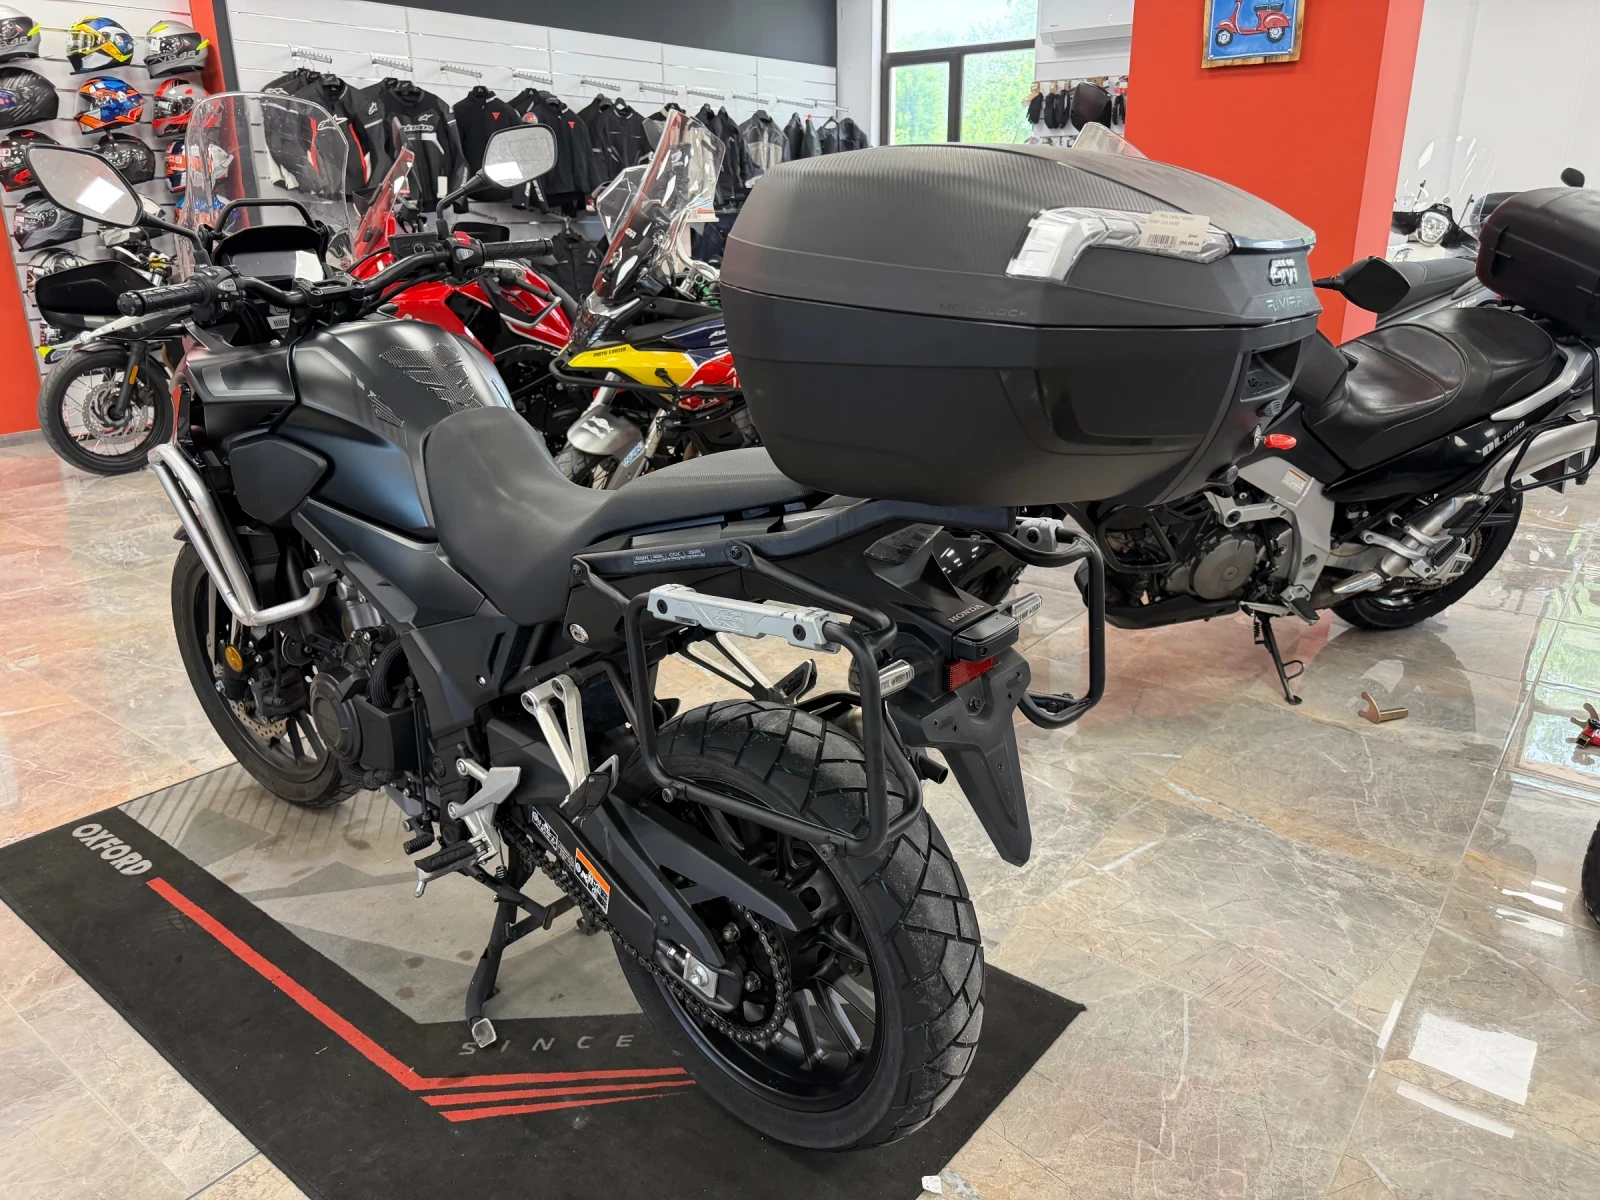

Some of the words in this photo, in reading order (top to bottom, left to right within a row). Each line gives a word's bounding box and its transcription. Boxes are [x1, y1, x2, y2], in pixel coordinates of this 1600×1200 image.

[1265, 295, 1310, 311] RIVIER
[947, 604, 984, 623] HONDA
[71, 823, 153, 876] OXFORD
[458, 1034, 634, 1055] SINCE
